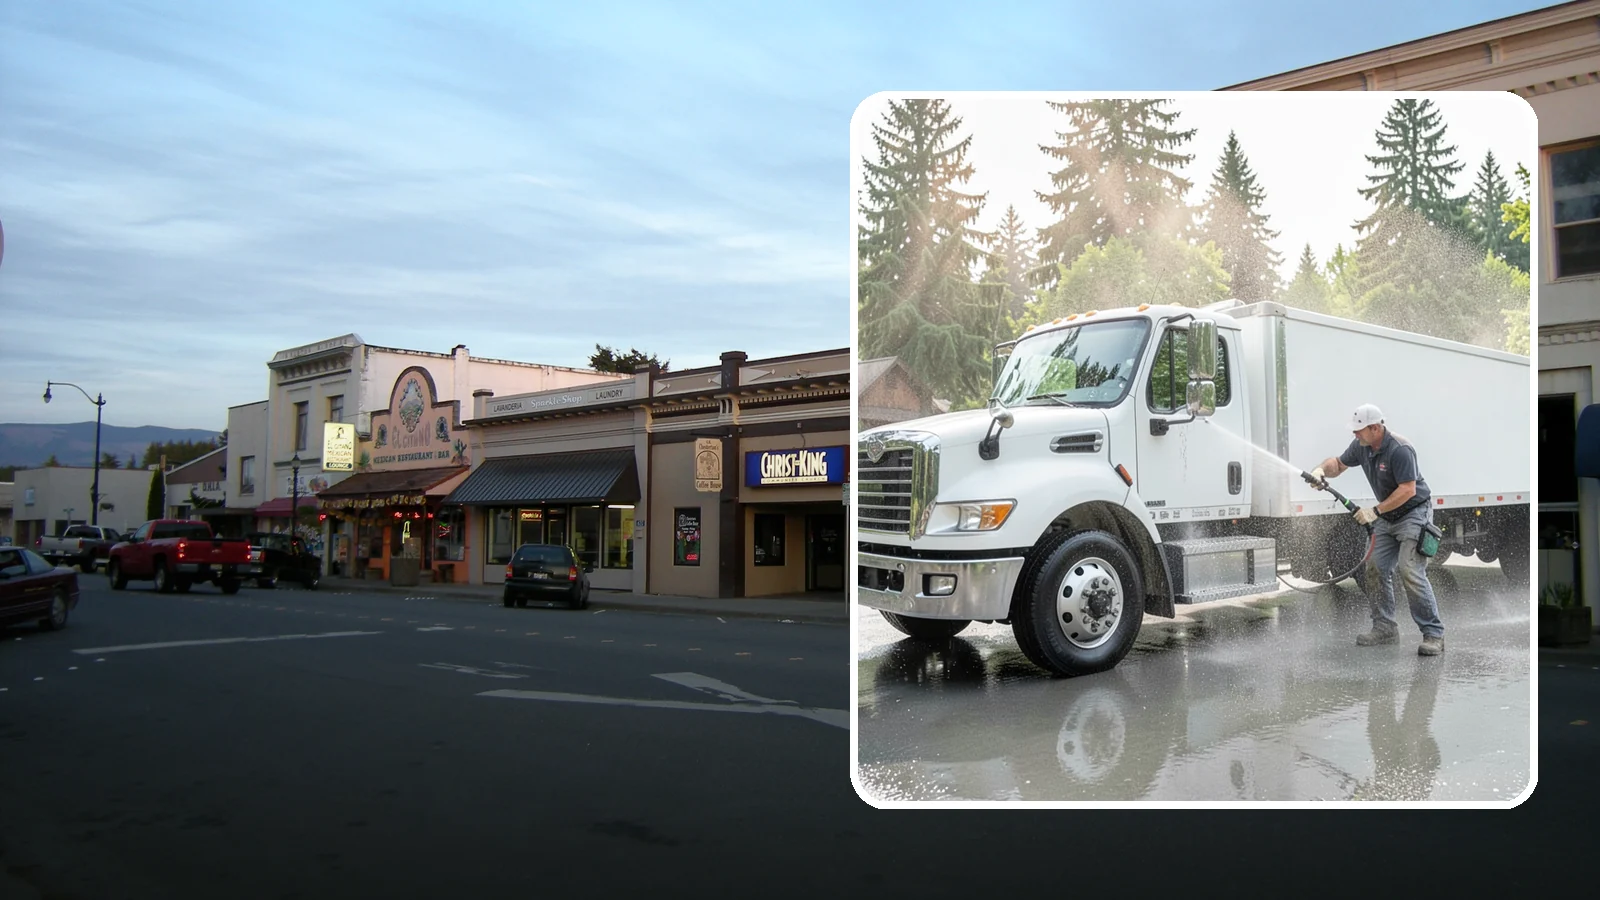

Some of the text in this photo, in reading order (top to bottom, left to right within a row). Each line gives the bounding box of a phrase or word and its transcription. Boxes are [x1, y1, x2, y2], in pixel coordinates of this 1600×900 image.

[595, 389, 623, 400] LAUNDRY
[531, 394, 582, 408] Sparkle Shop
[493, 402, 522, 413] LAVANDERIA
[397, 451, 433, 462] RESTAURANT
[437, 450, 450, 458] BAR
[761, 450, 827, 478] CHRIST KING
